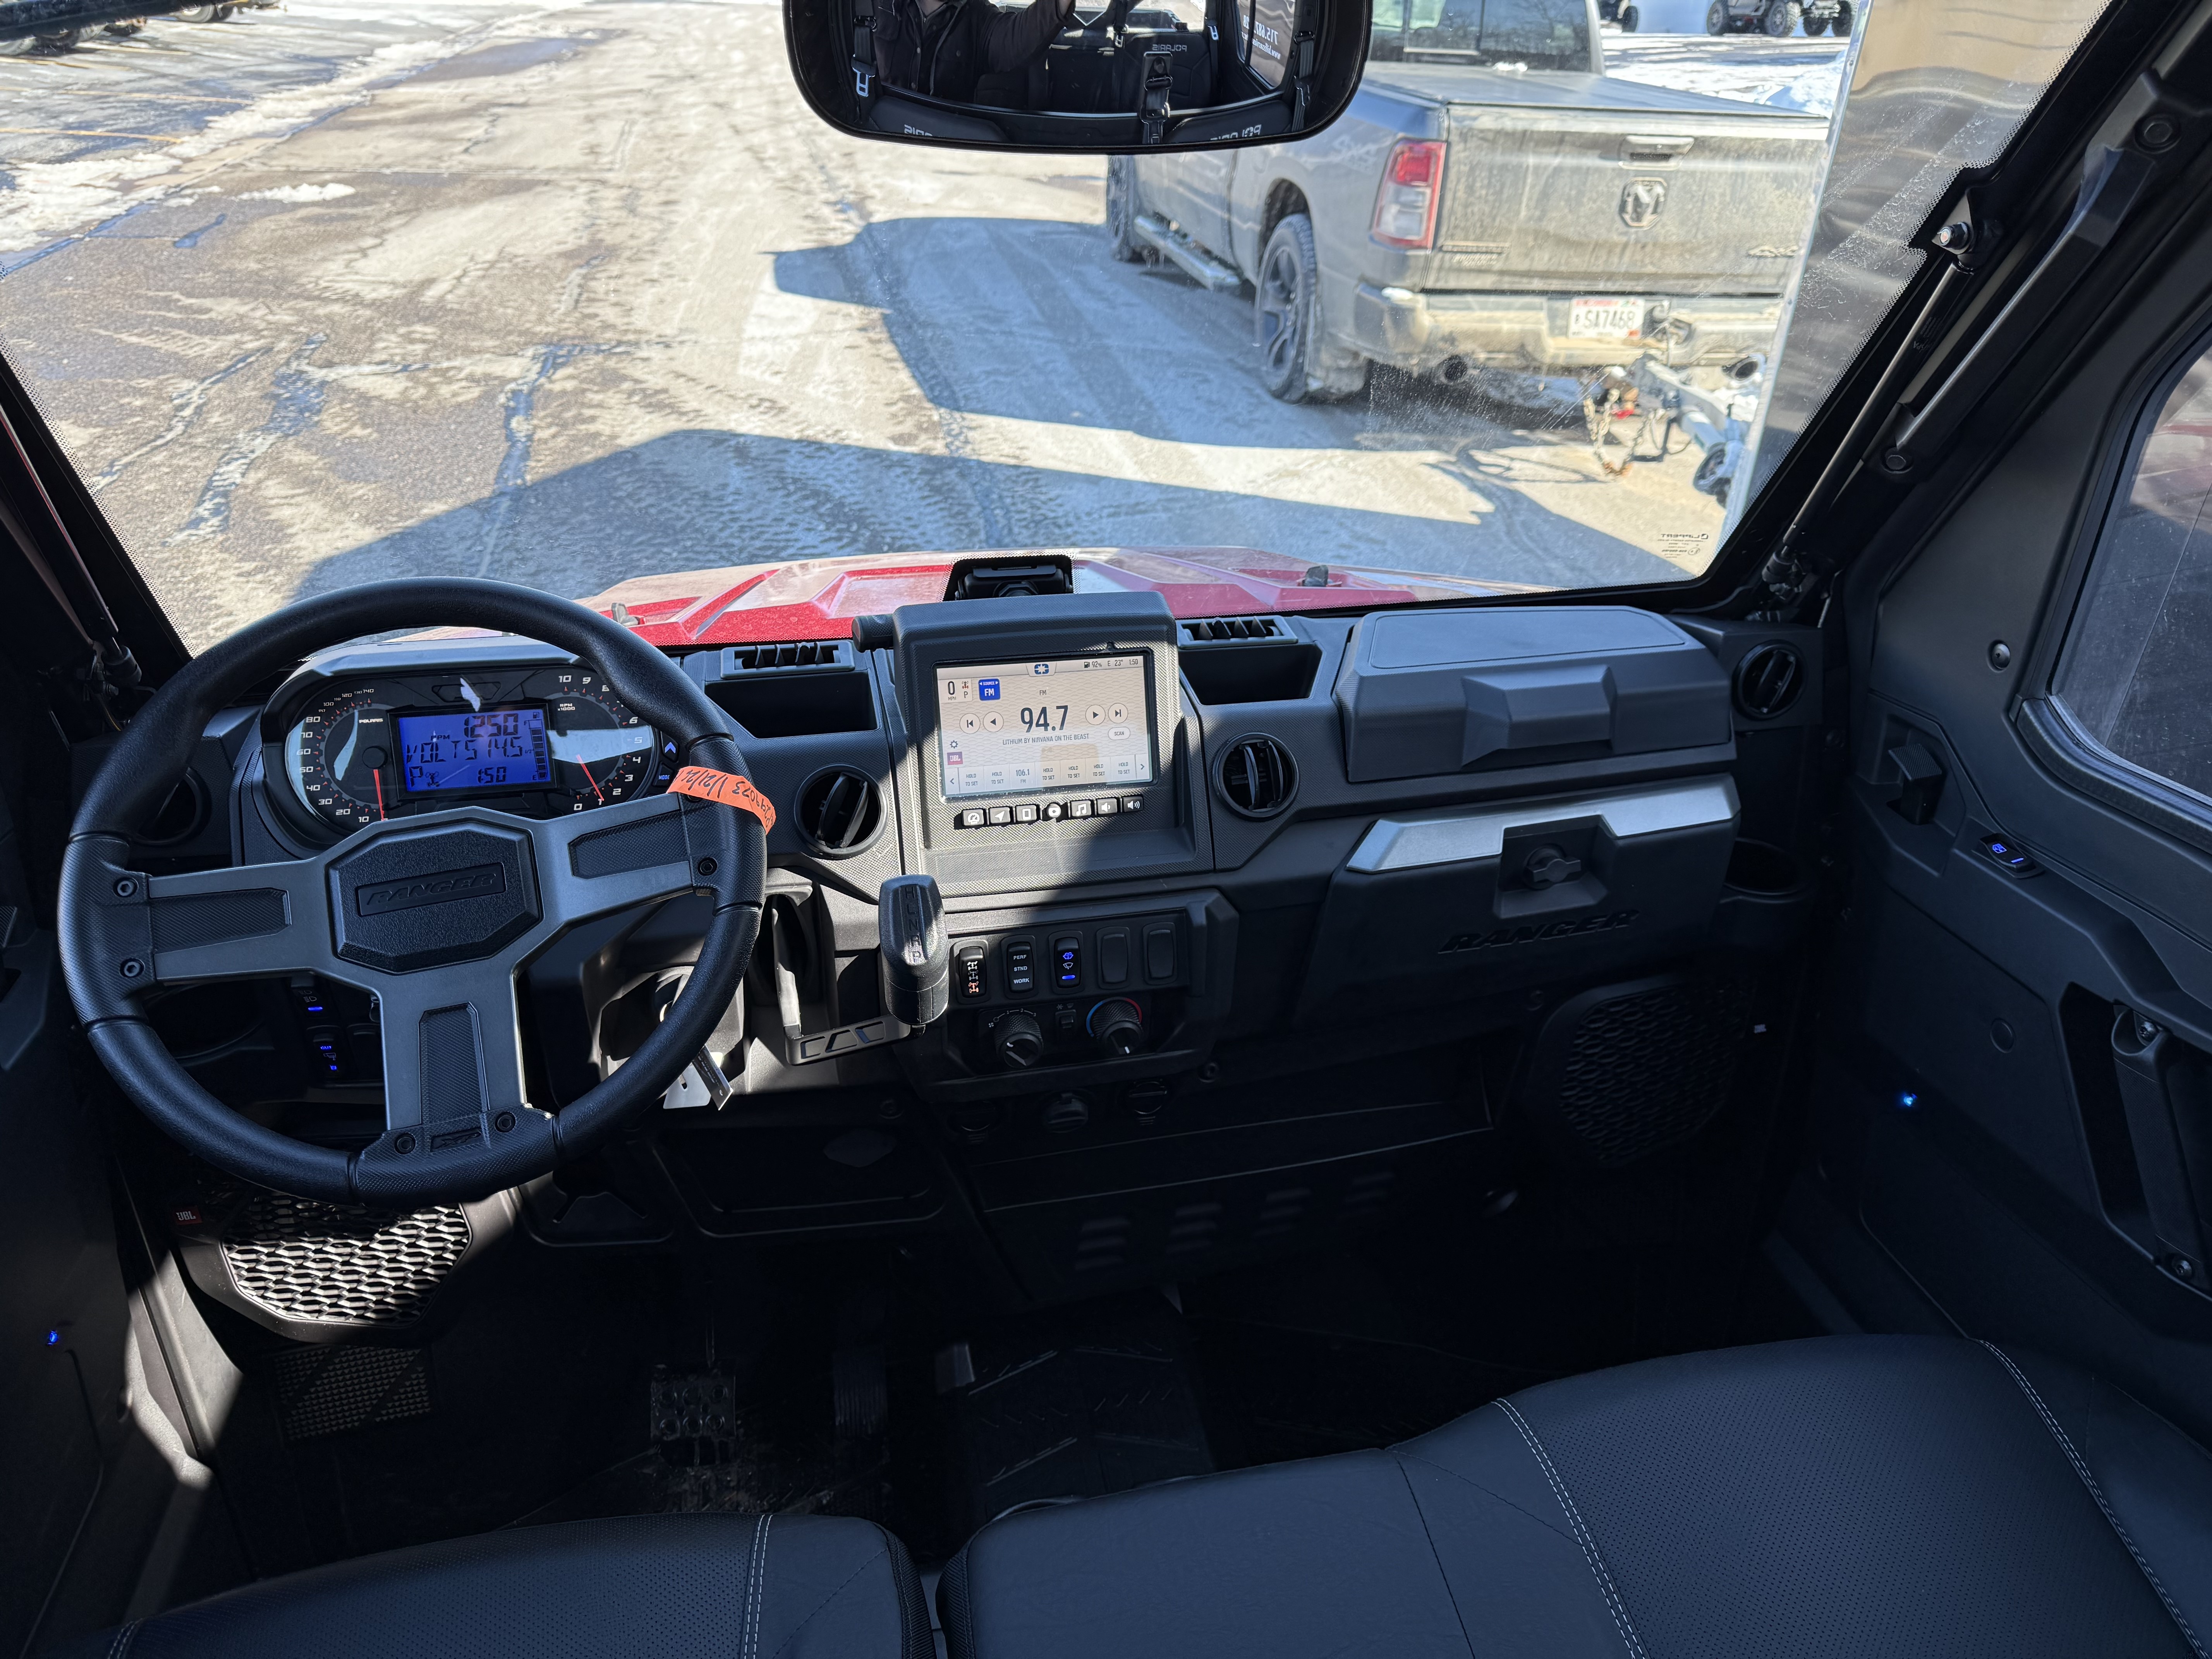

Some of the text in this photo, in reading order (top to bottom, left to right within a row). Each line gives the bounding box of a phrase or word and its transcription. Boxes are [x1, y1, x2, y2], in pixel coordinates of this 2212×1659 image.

[948, 681, 955, 695] 0
[984, 688, 994, 696] FM
[464, 713, 519, 738] 1250
[1020, 705, 1068, 733] 94.7
[407, 737, 522, 764] VOLTS 14.5
[409, 766, 422, 787] P
[478, 766, 507, 783] 1:50
[367, 874, 496, 905] RANGER
[905, 886, 915, 899] H
[907, 904, 917, 915] L
[908, 919, 919, 931] N
[1438, 909, 1640, 954] RANGER
[912, 951, 921, 963] P
[434, 1132, 482, 1149] XP
[176, 1211, 196, 1221] JBL
